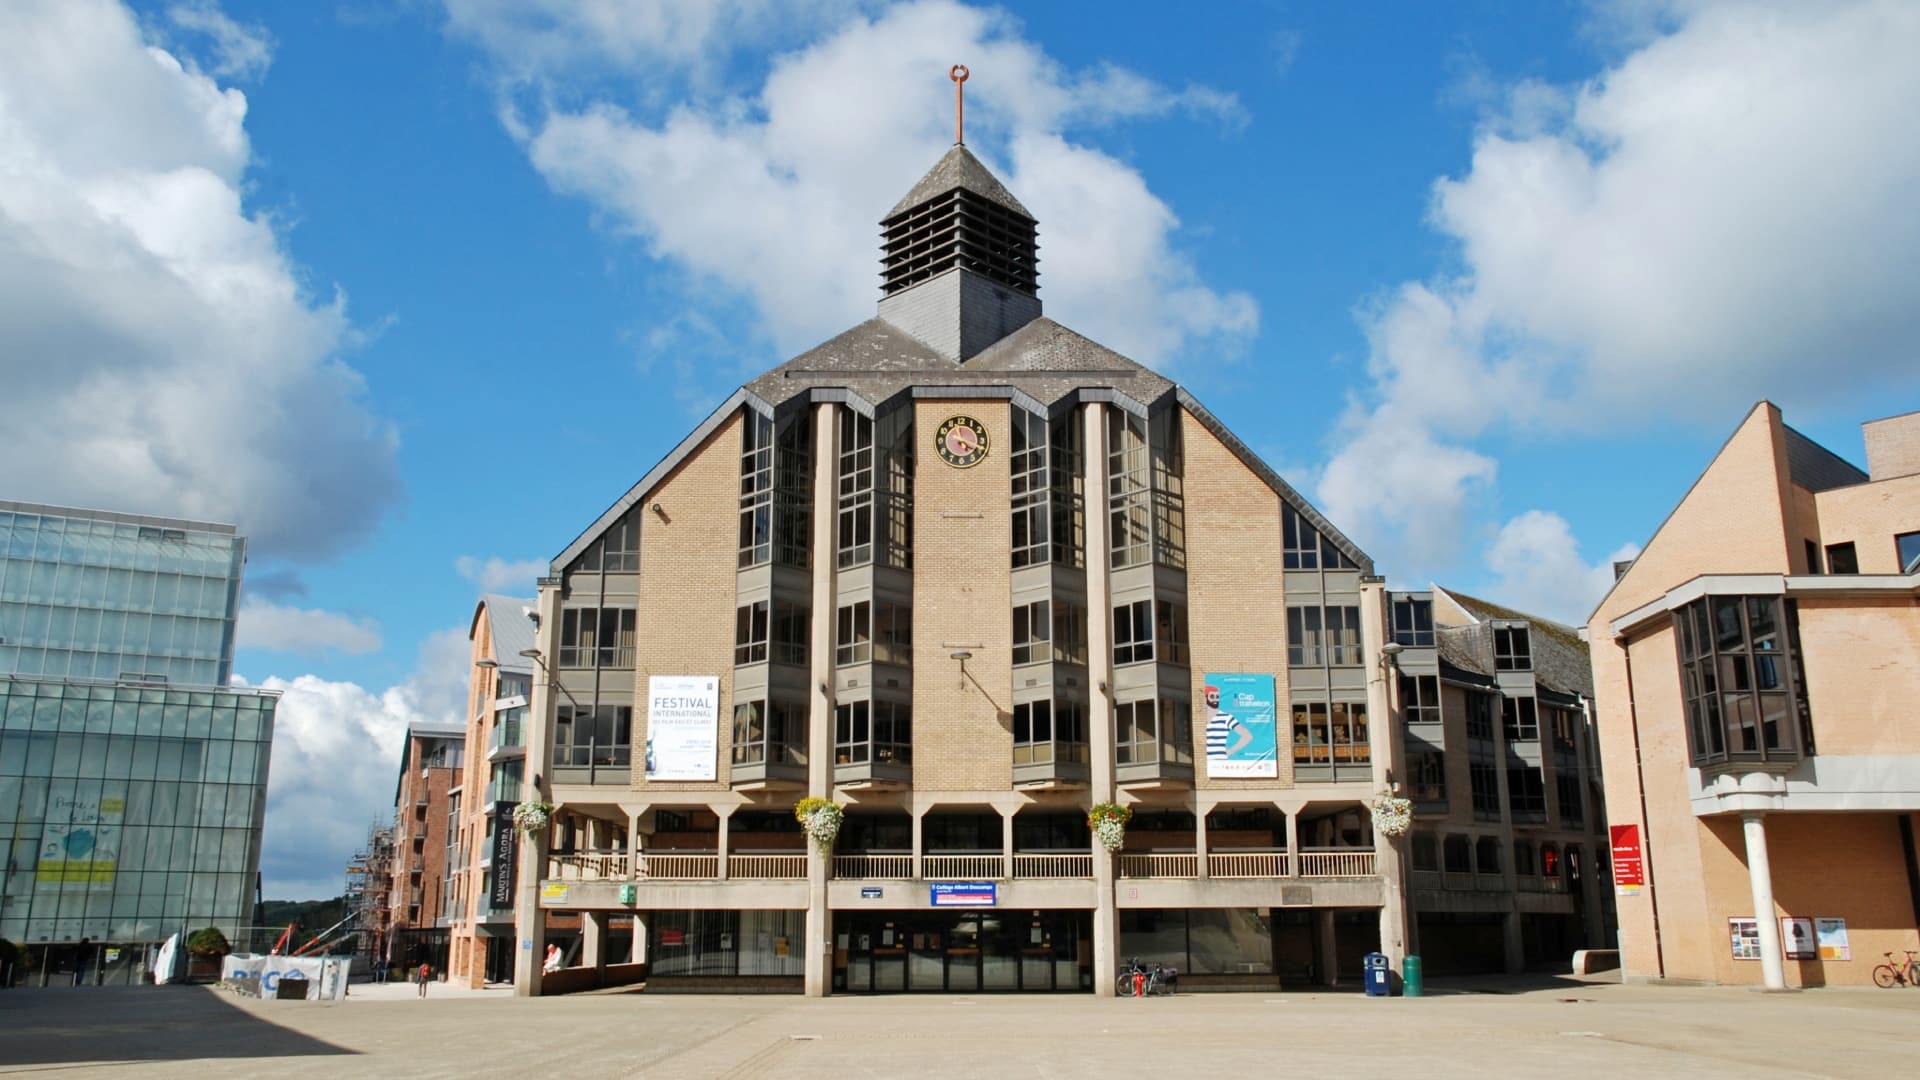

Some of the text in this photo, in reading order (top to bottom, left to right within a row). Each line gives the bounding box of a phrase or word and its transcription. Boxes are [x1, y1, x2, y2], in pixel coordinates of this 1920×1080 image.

[1238, 692, 1254, 701] Cap
[654, 697, 713, 709] FESTIVAL
[653, 709, 712, 718] INTERNATIONAL
